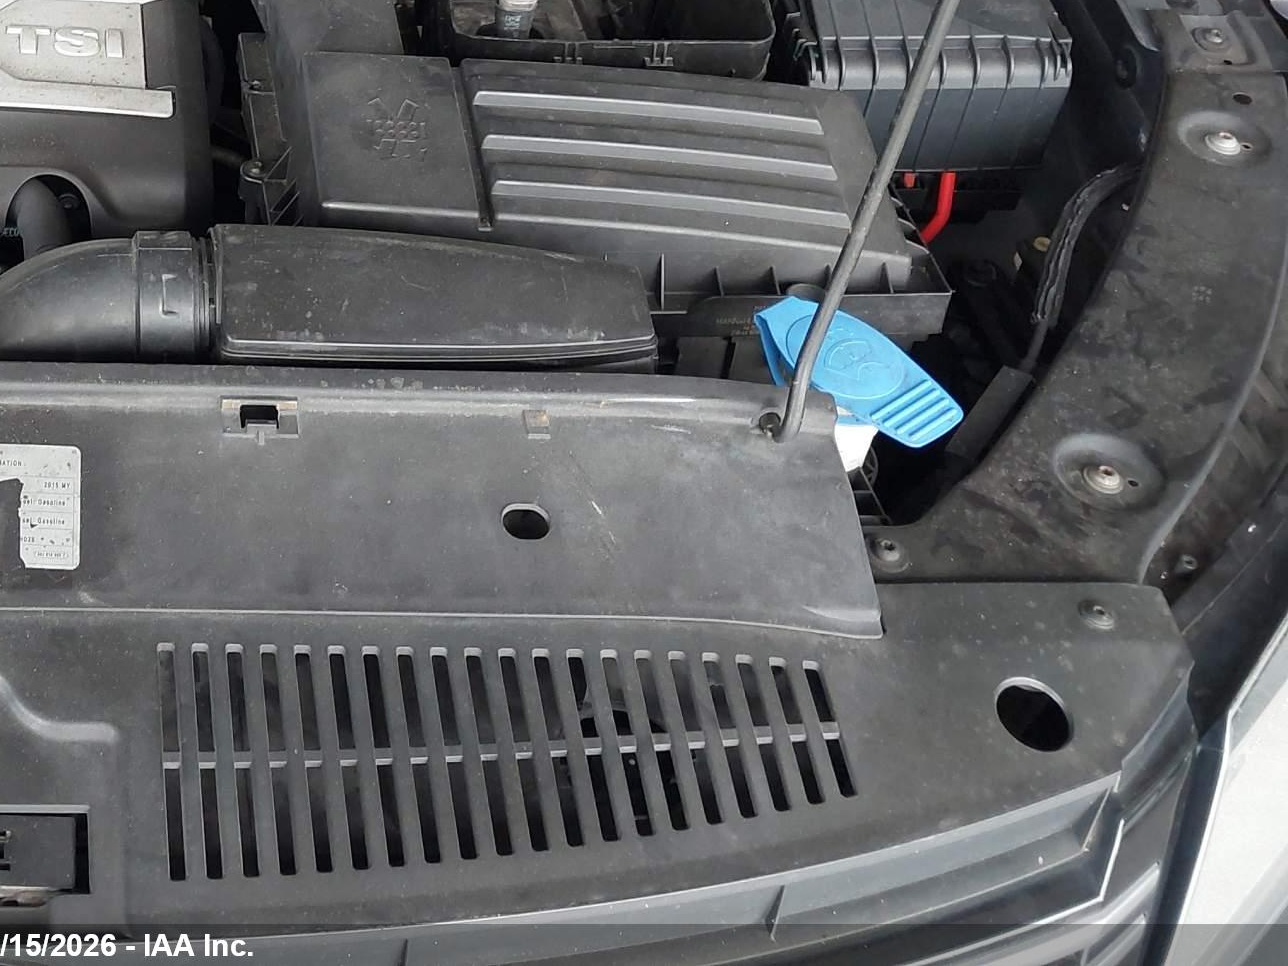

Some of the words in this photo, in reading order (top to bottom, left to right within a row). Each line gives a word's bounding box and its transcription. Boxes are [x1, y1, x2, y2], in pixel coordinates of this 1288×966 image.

[5, 24, 124, 58] TSI
[37, 498, 66, 507] Gasoline
[37, 516, 65, 525] Gasoline
